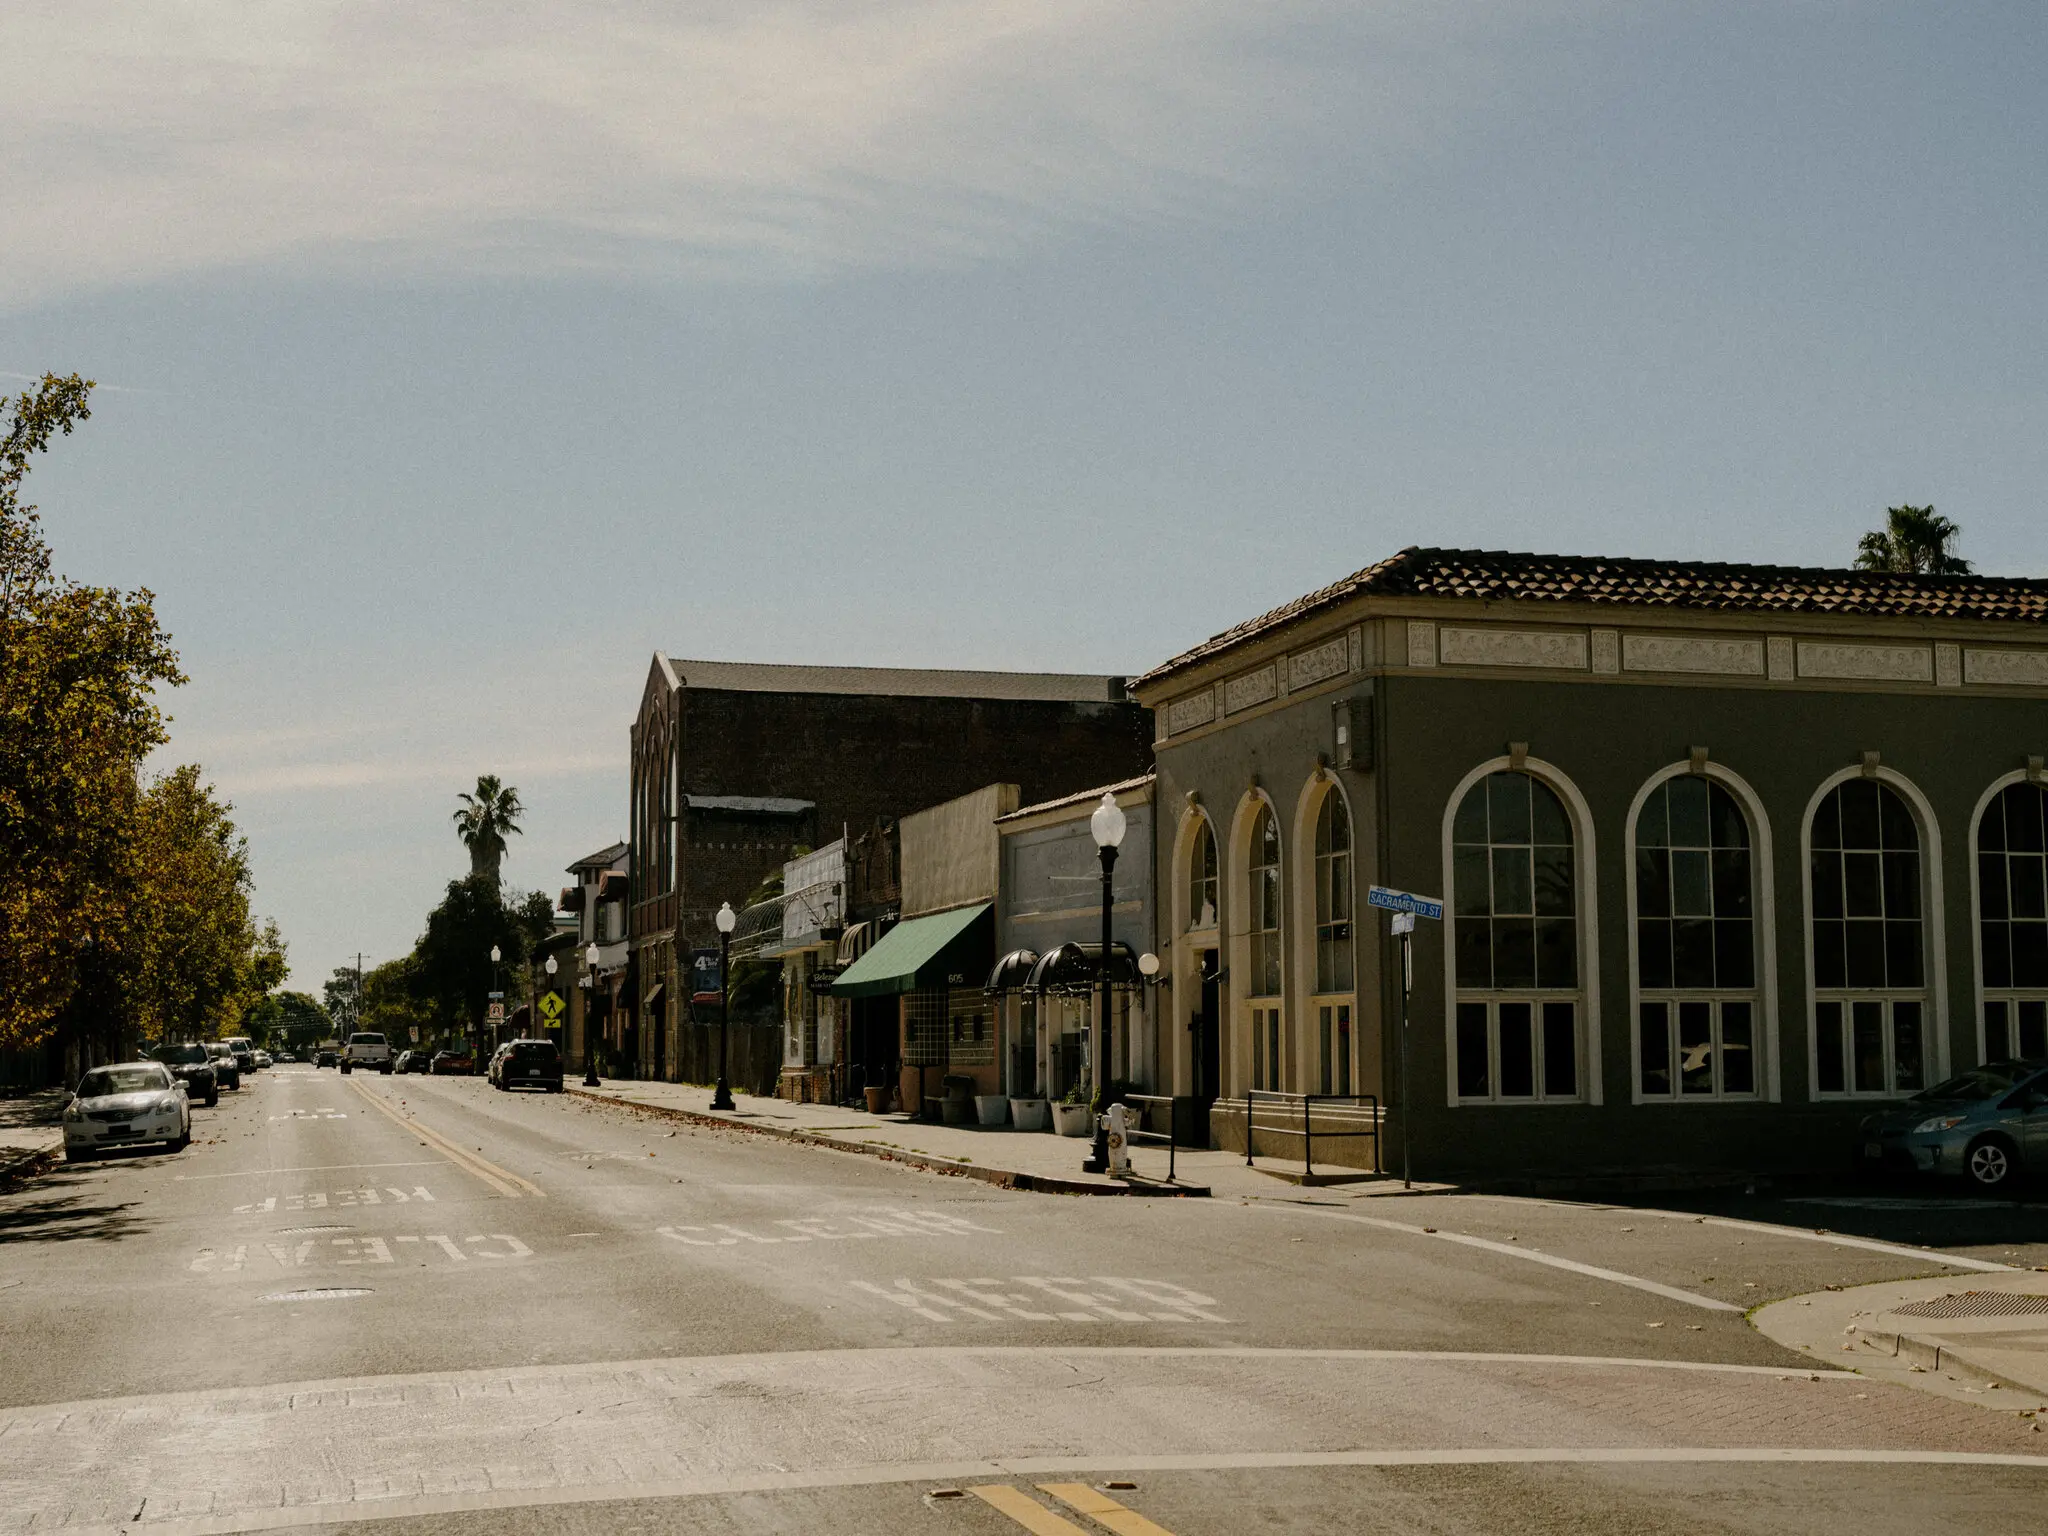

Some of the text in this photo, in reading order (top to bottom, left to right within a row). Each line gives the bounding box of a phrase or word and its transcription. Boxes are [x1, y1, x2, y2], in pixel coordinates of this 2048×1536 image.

[1370, 892, 1441, 916] SACRAMENTO ST
[948, 973, 964, 984] 605
[233, 1186, 435, 1213] KEEP
[655, 1208, 1005, 1245] CLEAR
[190, 1234, 534, 1272] CLEAR
[842, 1277, 1231, 1323] KEEP
